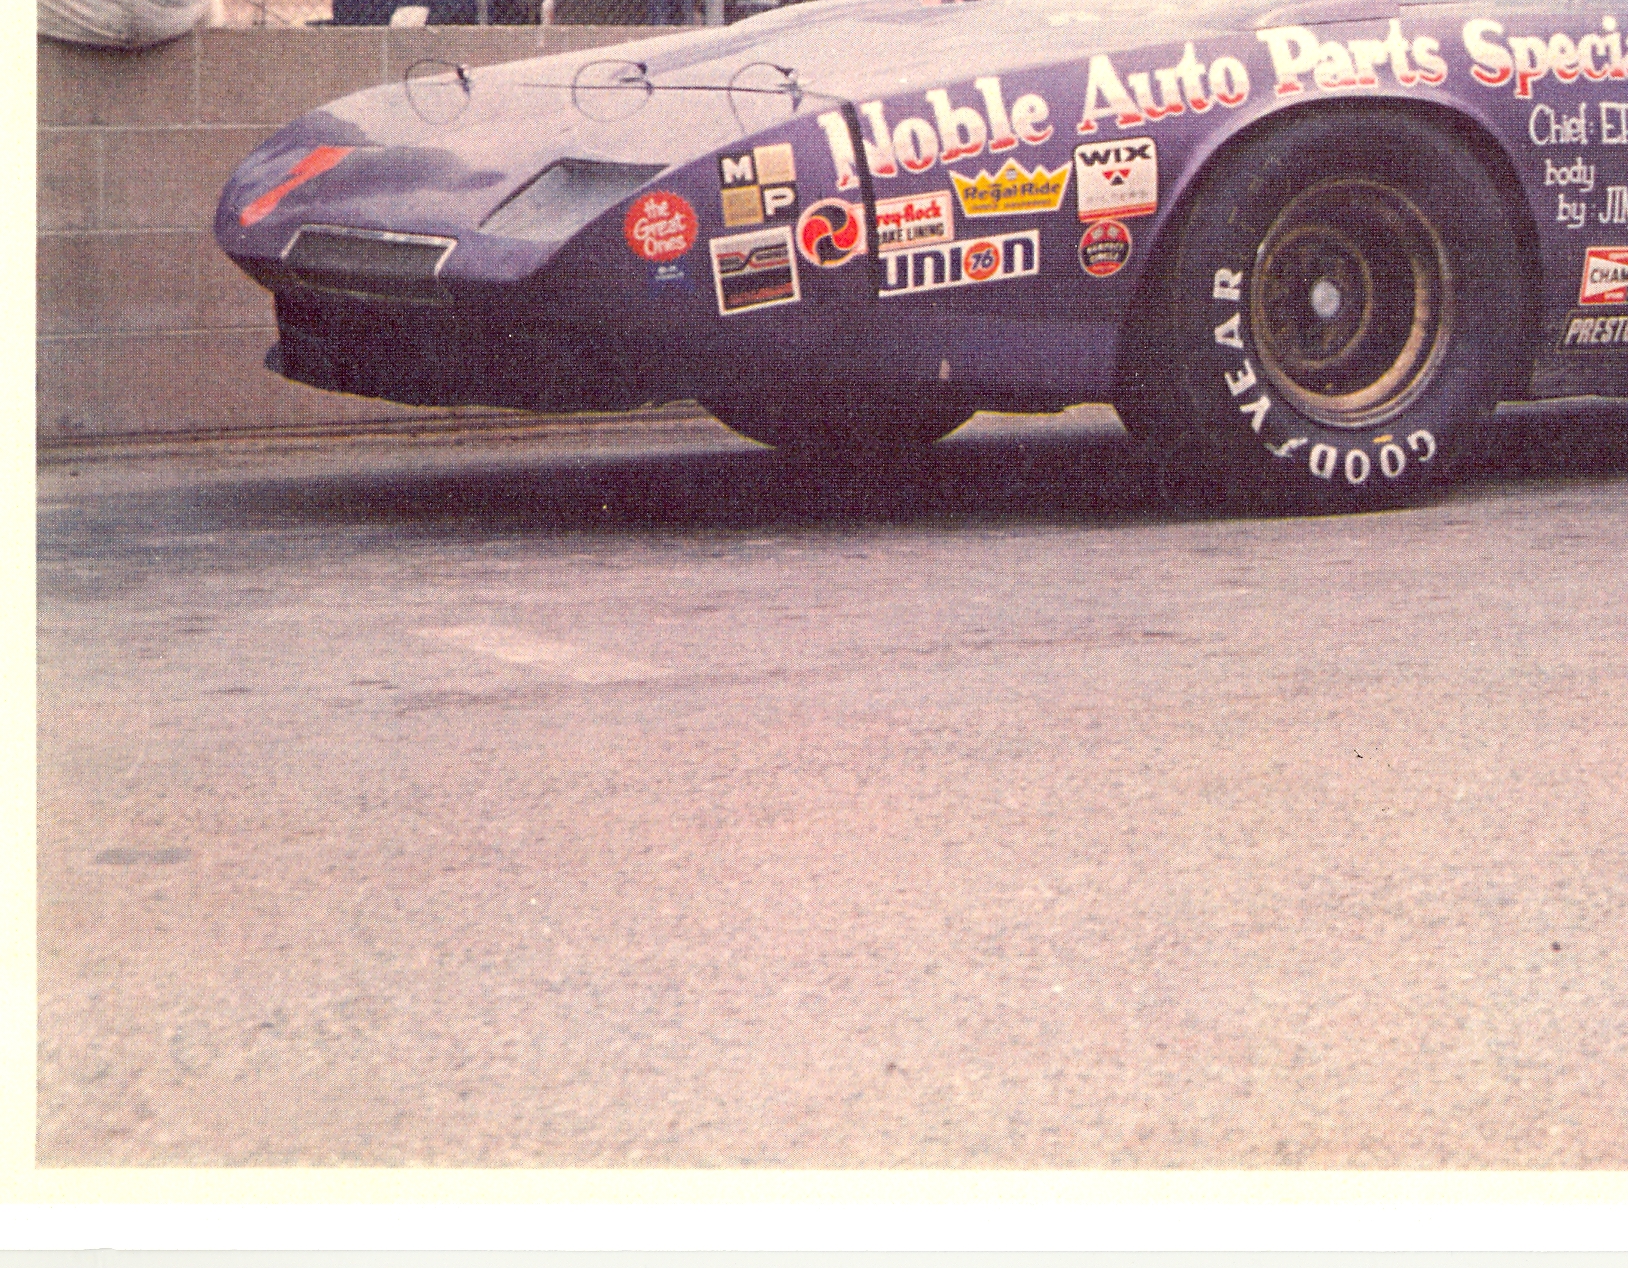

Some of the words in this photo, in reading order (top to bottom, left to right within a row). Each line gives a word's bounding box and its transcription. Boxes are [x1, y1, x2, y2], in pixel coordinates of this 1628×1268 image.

[817, 74, 1055, 190] Noble
[1075, 40, 1251, 136] Auto
[1257, 18, 1449, 99] Parts
[1079, 143, 1152, 167] WIX
[1544, 156, 1595, 193] body
[962, 182, 1018, 203] Regal
[1020, 181, 1062, 199] Ride
[644, 198, 670, 219] the
[633, 211, 687, 241] Great
[906, 221, 945, 241] LINING
[643, 235, 688, 257] Ones
[969, 249, 994, 271] 76
[1212, 266, 1437, 485] GOODYEAR
